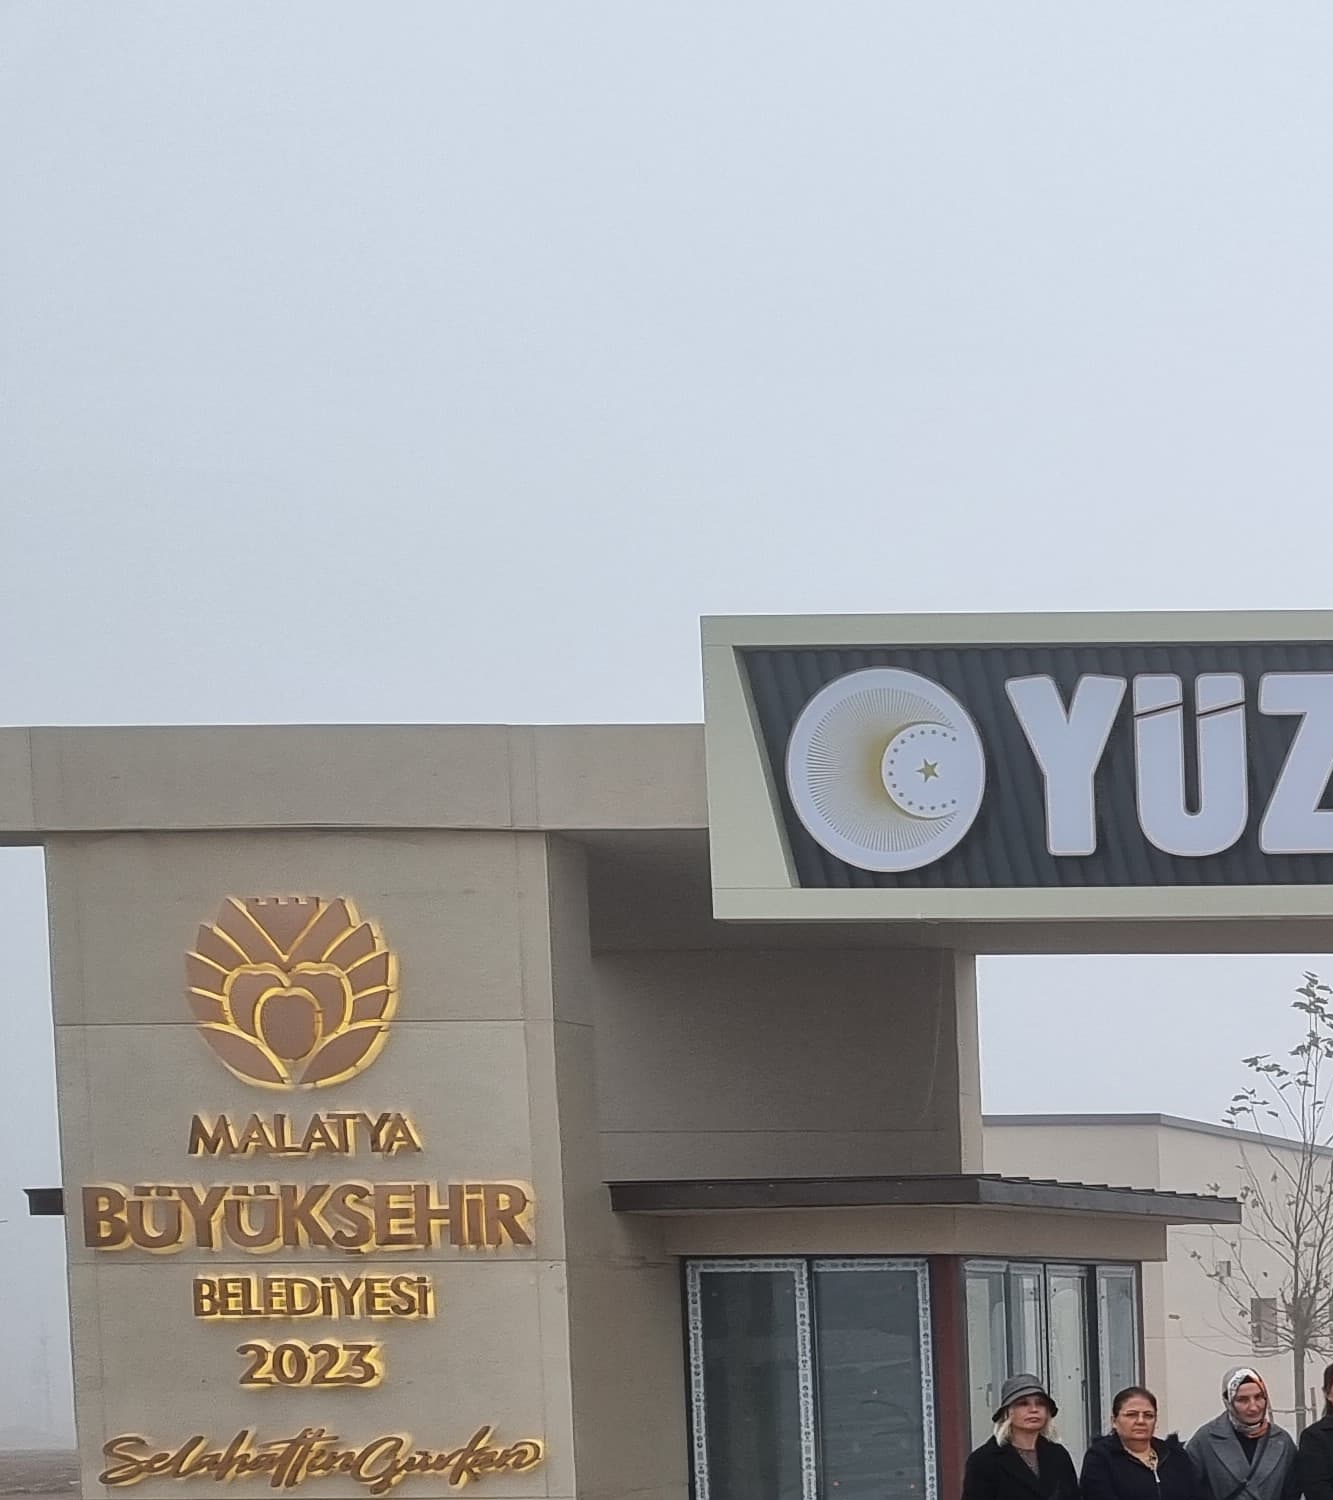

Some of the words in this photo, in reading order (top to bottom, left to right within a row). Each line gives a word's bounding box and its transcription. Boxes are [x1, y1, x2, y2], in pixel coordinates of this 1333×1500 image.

[188, 1112, 423, 1156] MALATYA
[82, 1182, 535, 1254] BÜYÜKŞEHİR
[193, 1276, 433, 1319] BELEDİYESİ
[236, 1343, 379, 1387] 2023
